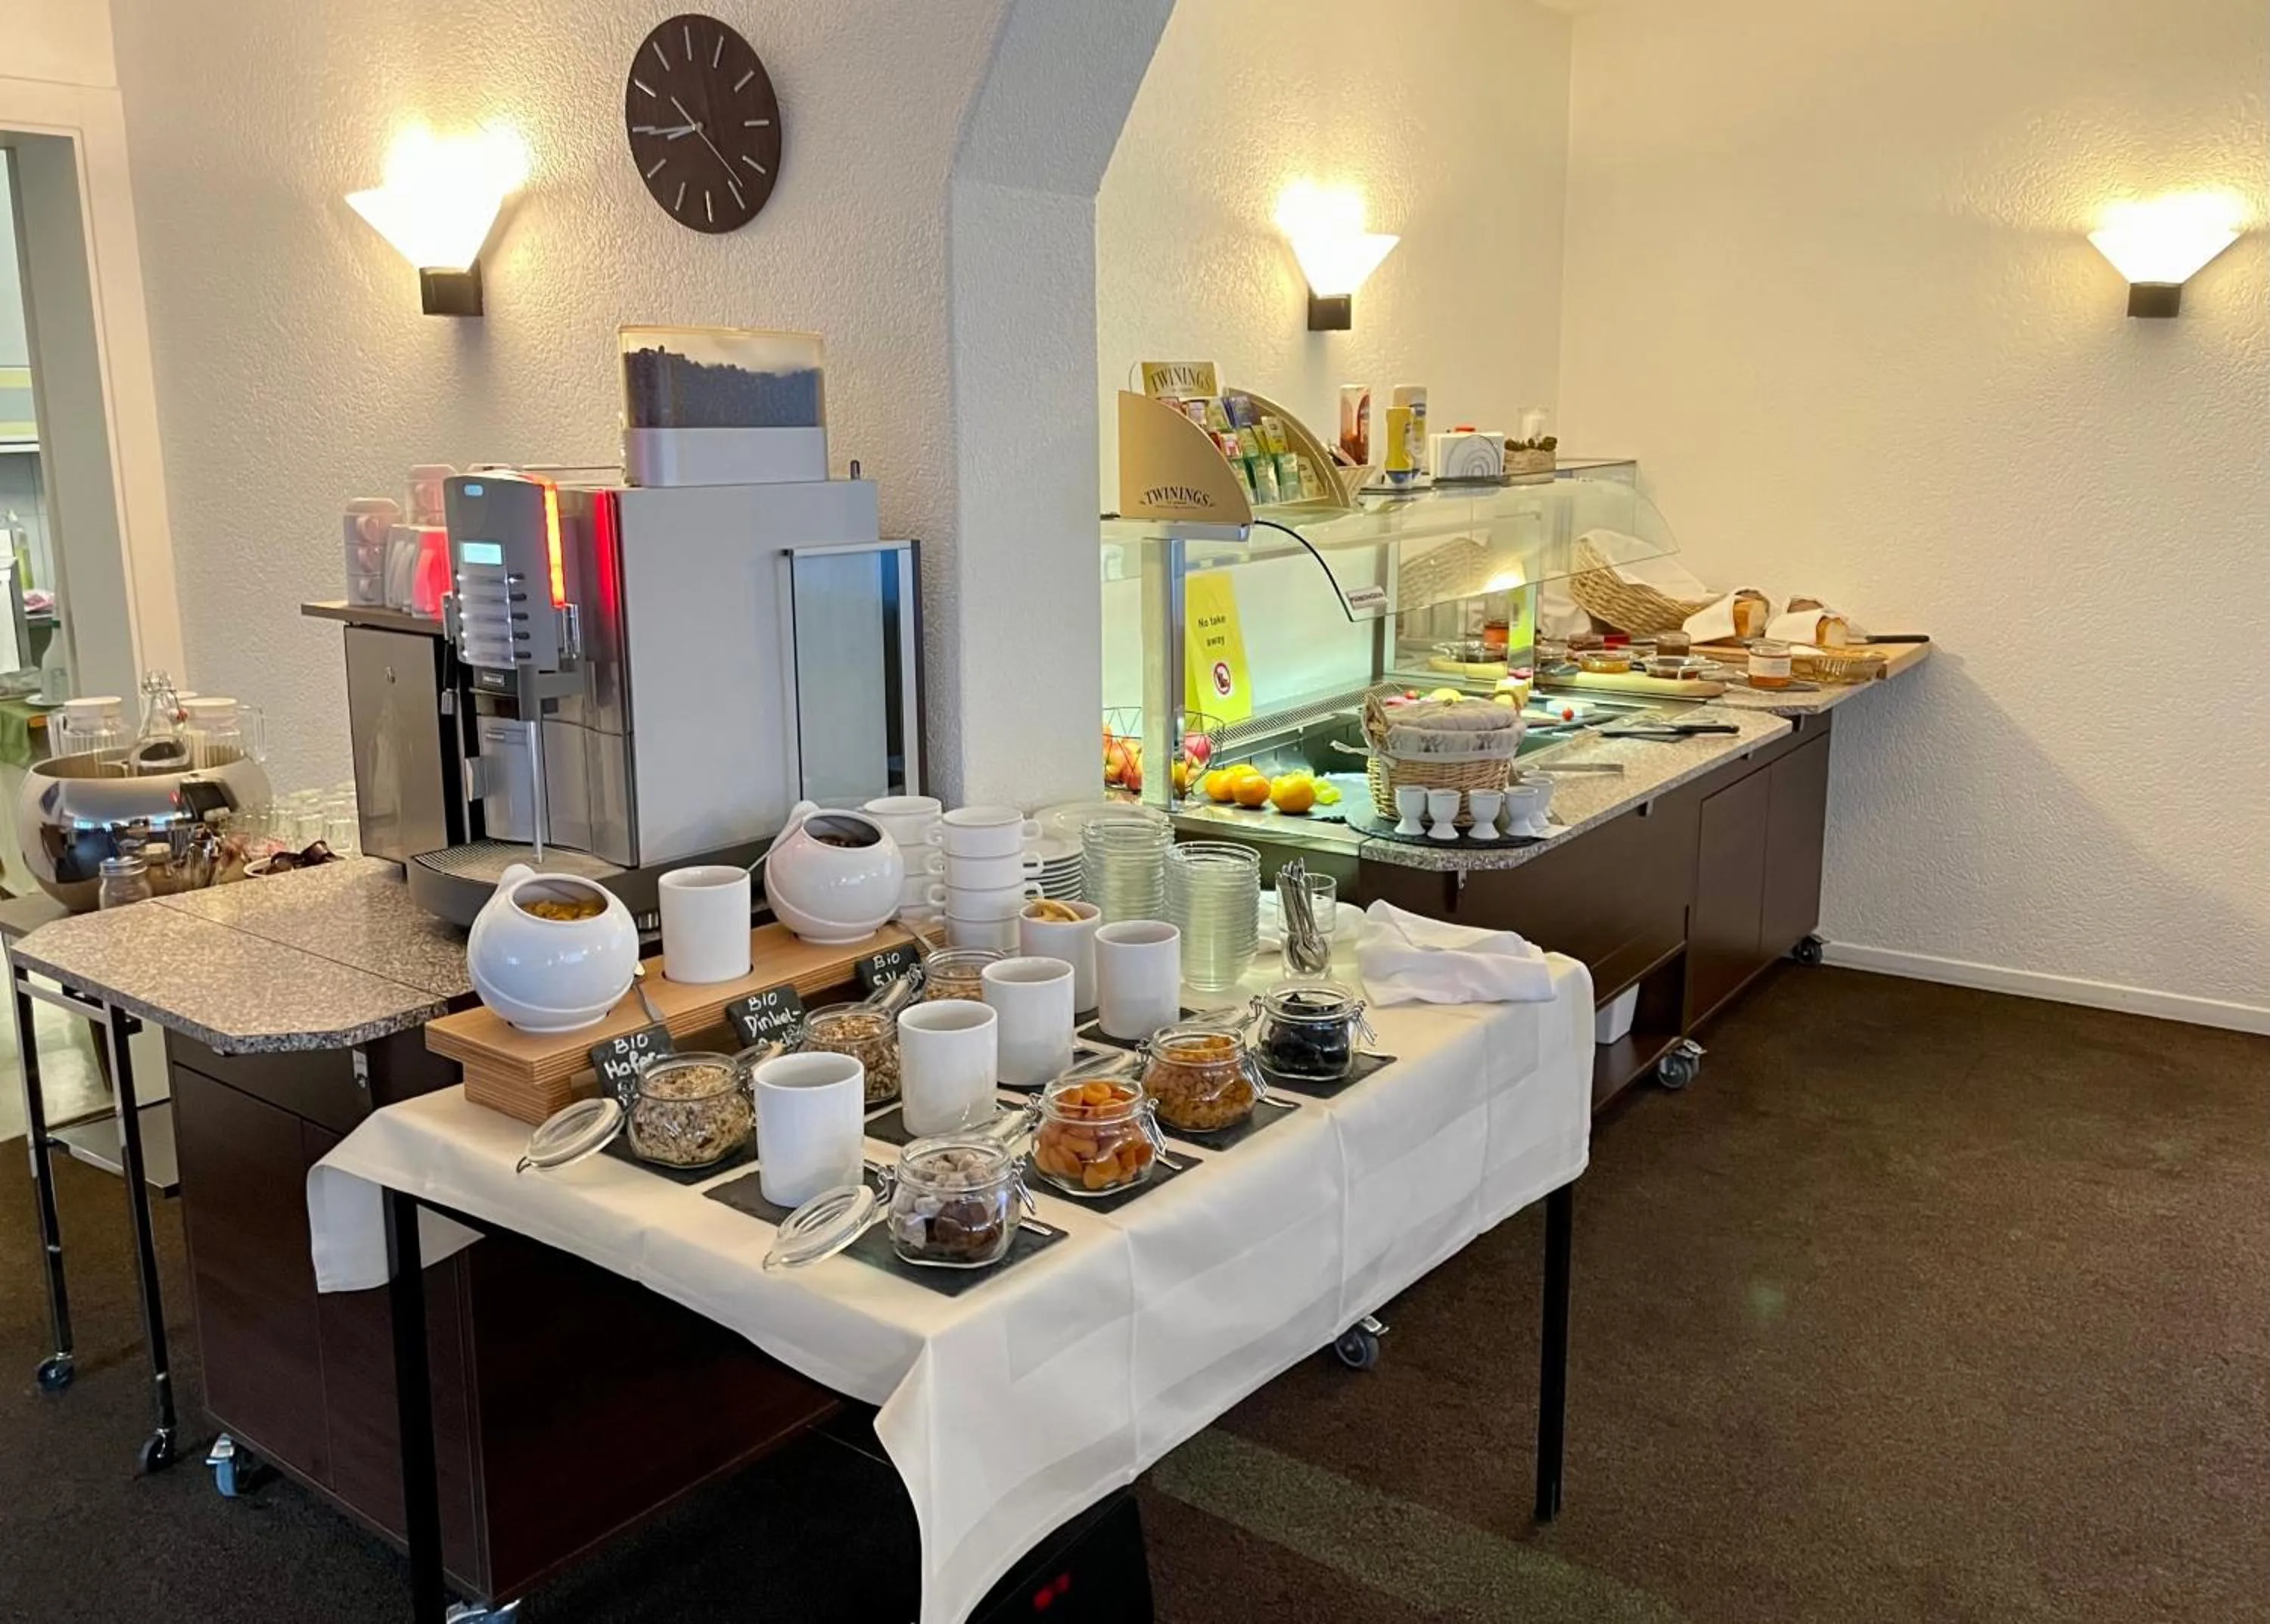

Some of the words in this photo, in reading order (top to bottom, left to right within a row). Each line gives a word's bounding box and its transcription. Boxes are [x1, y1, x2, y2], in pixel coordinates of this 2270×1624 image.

[1150, 366, 1211, 393] TWININGS
[1143, 486, 1210, 507] TWININGS
[1198, 618, 1208, 627] No
[1206, 636, 1225, 646] away
[744, 1007, 801, 1038] Dinkel-
